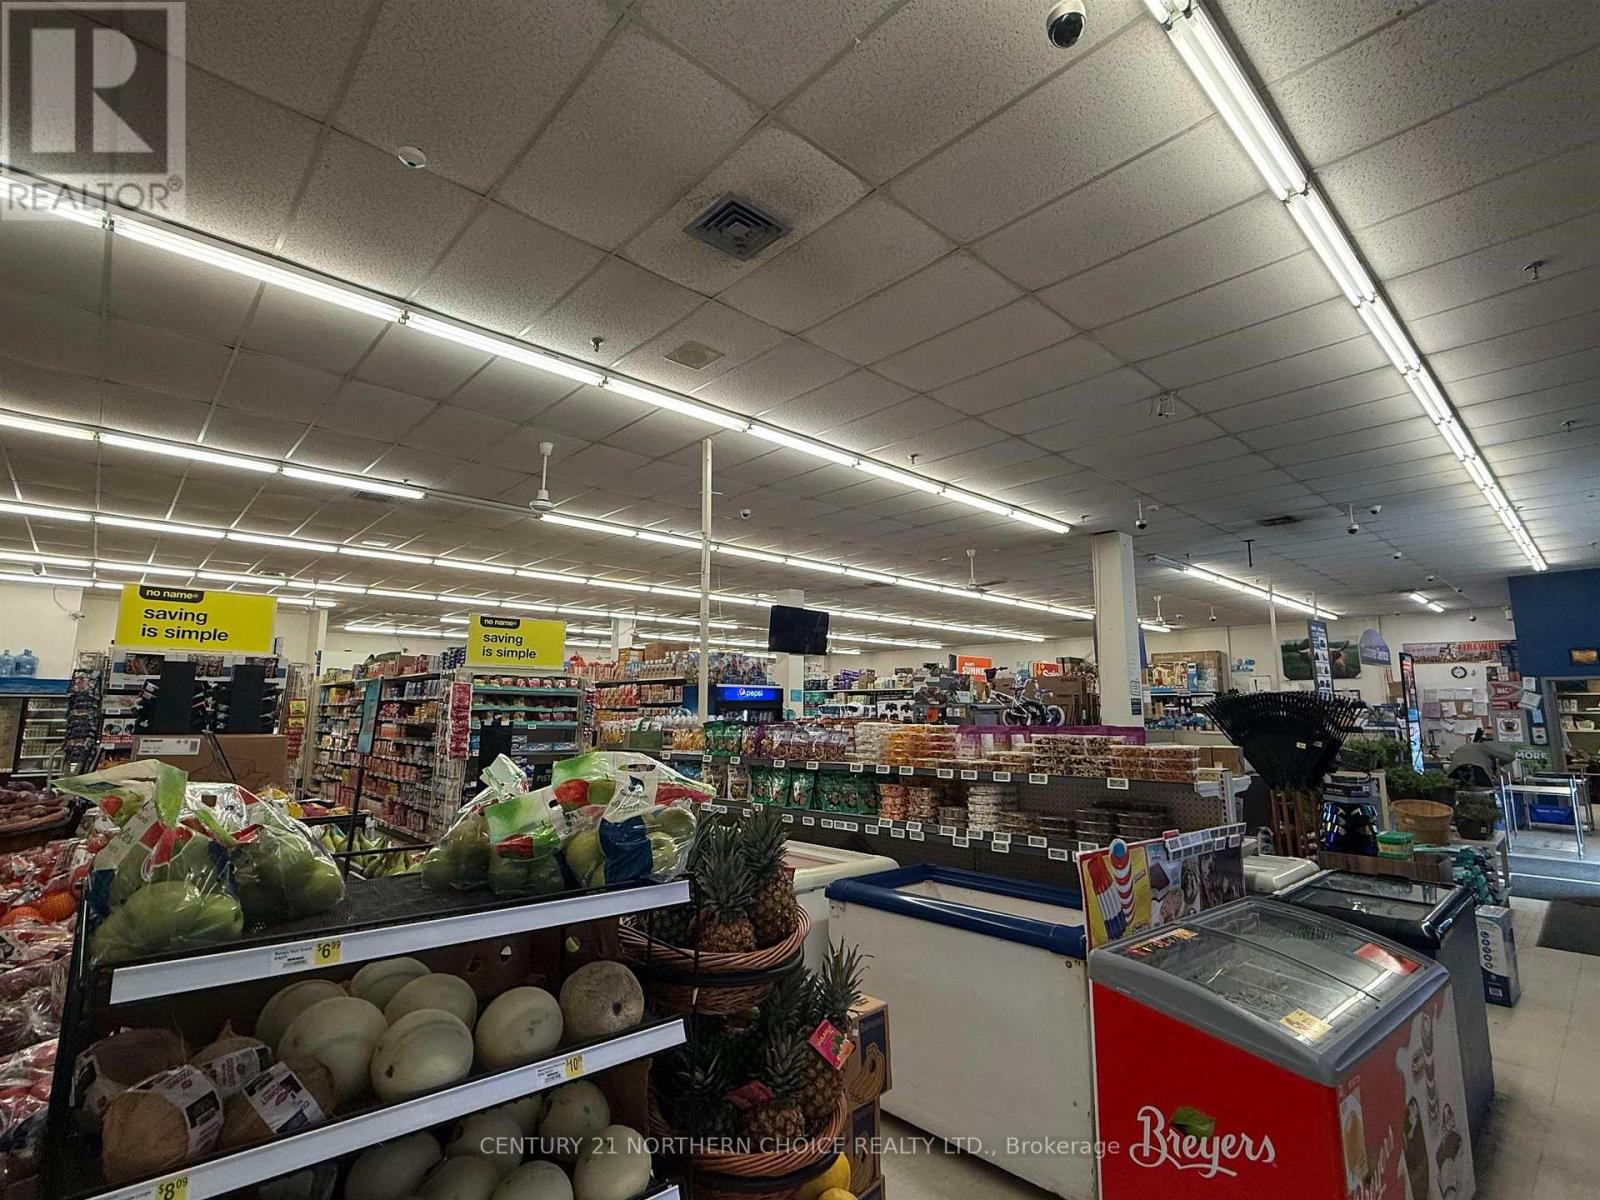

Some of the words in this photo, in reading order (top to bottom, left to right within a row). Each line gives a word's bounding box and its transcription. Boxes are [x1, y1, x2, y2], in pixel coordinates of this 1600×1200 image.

[146, 589, 161, 597] no
[143, 607, 208, 625] saving
[484, 617, 494, 626] no
[141, 624, 158, 637] is
[164, 627, 229, 643] simple
[483, 632, 523, 647] saving
[482, 645, 493, 657] is
[495, 647, 537, 660] simple
[746, 688, 763, 698] pepsi
[1128, 1105, 1276, 1178] Breyers
